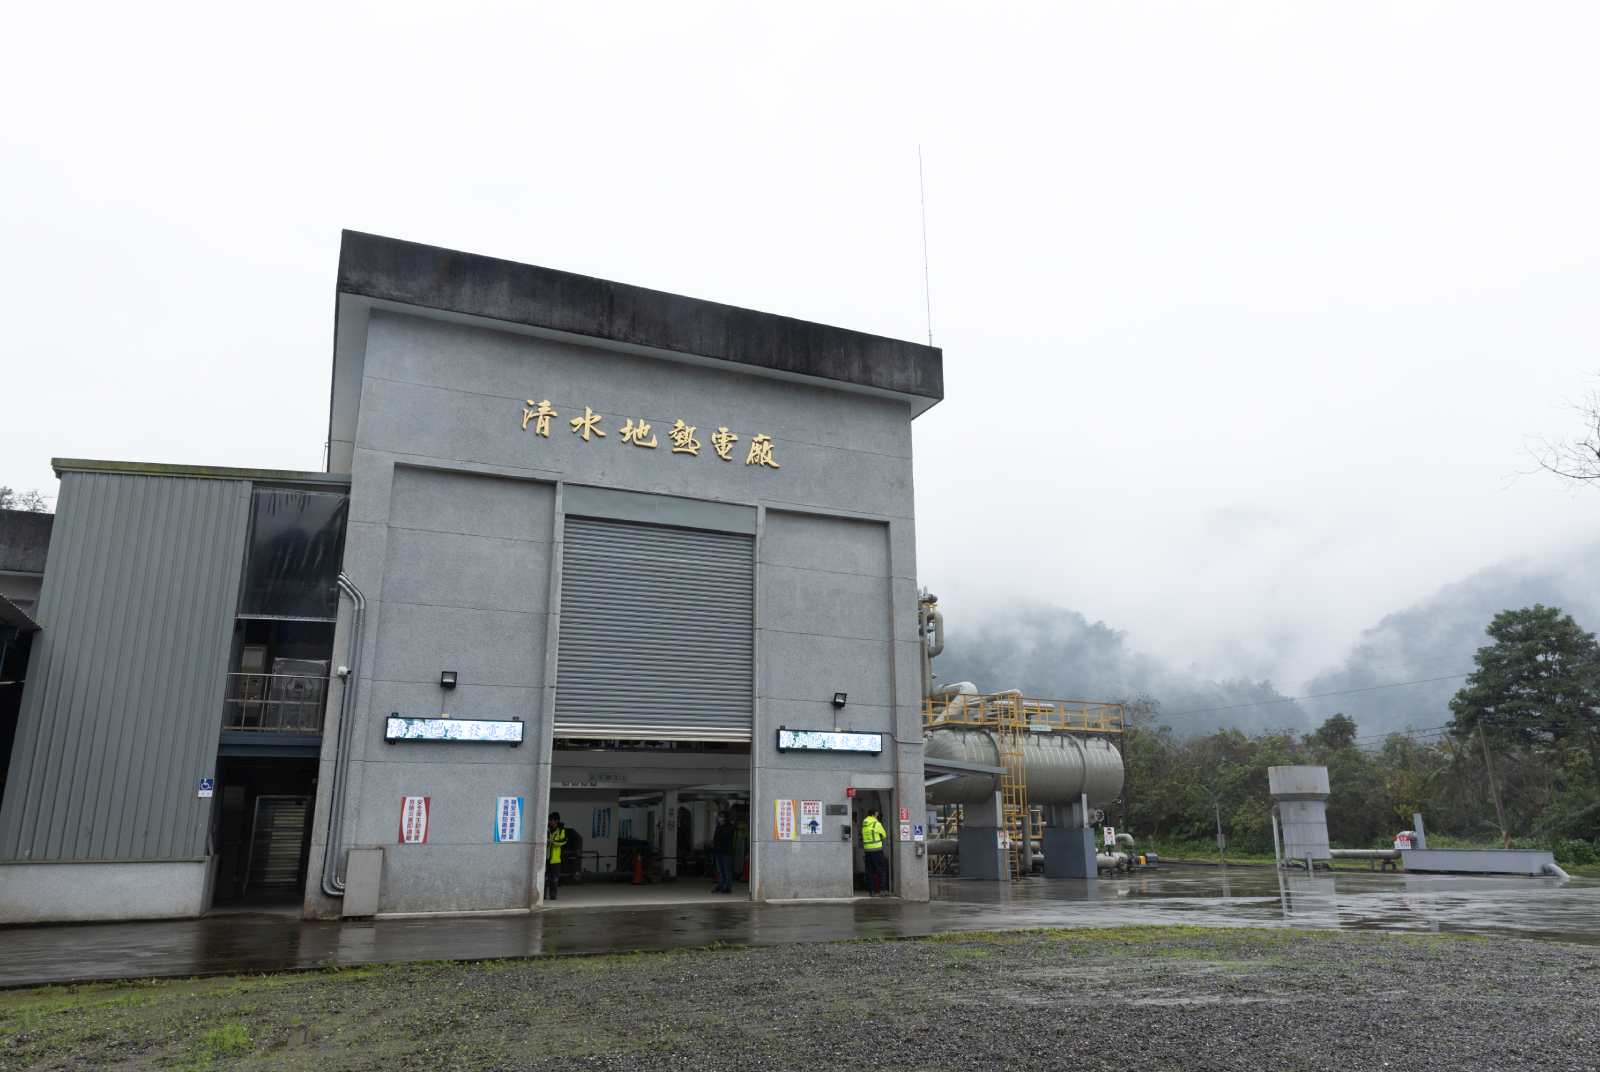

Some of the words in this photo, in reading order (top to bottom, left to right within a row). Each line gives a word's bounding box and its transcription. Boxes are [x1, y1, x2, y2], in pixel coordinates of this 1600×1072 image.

[522, 399, 781, 468] 清水地熱電廠
